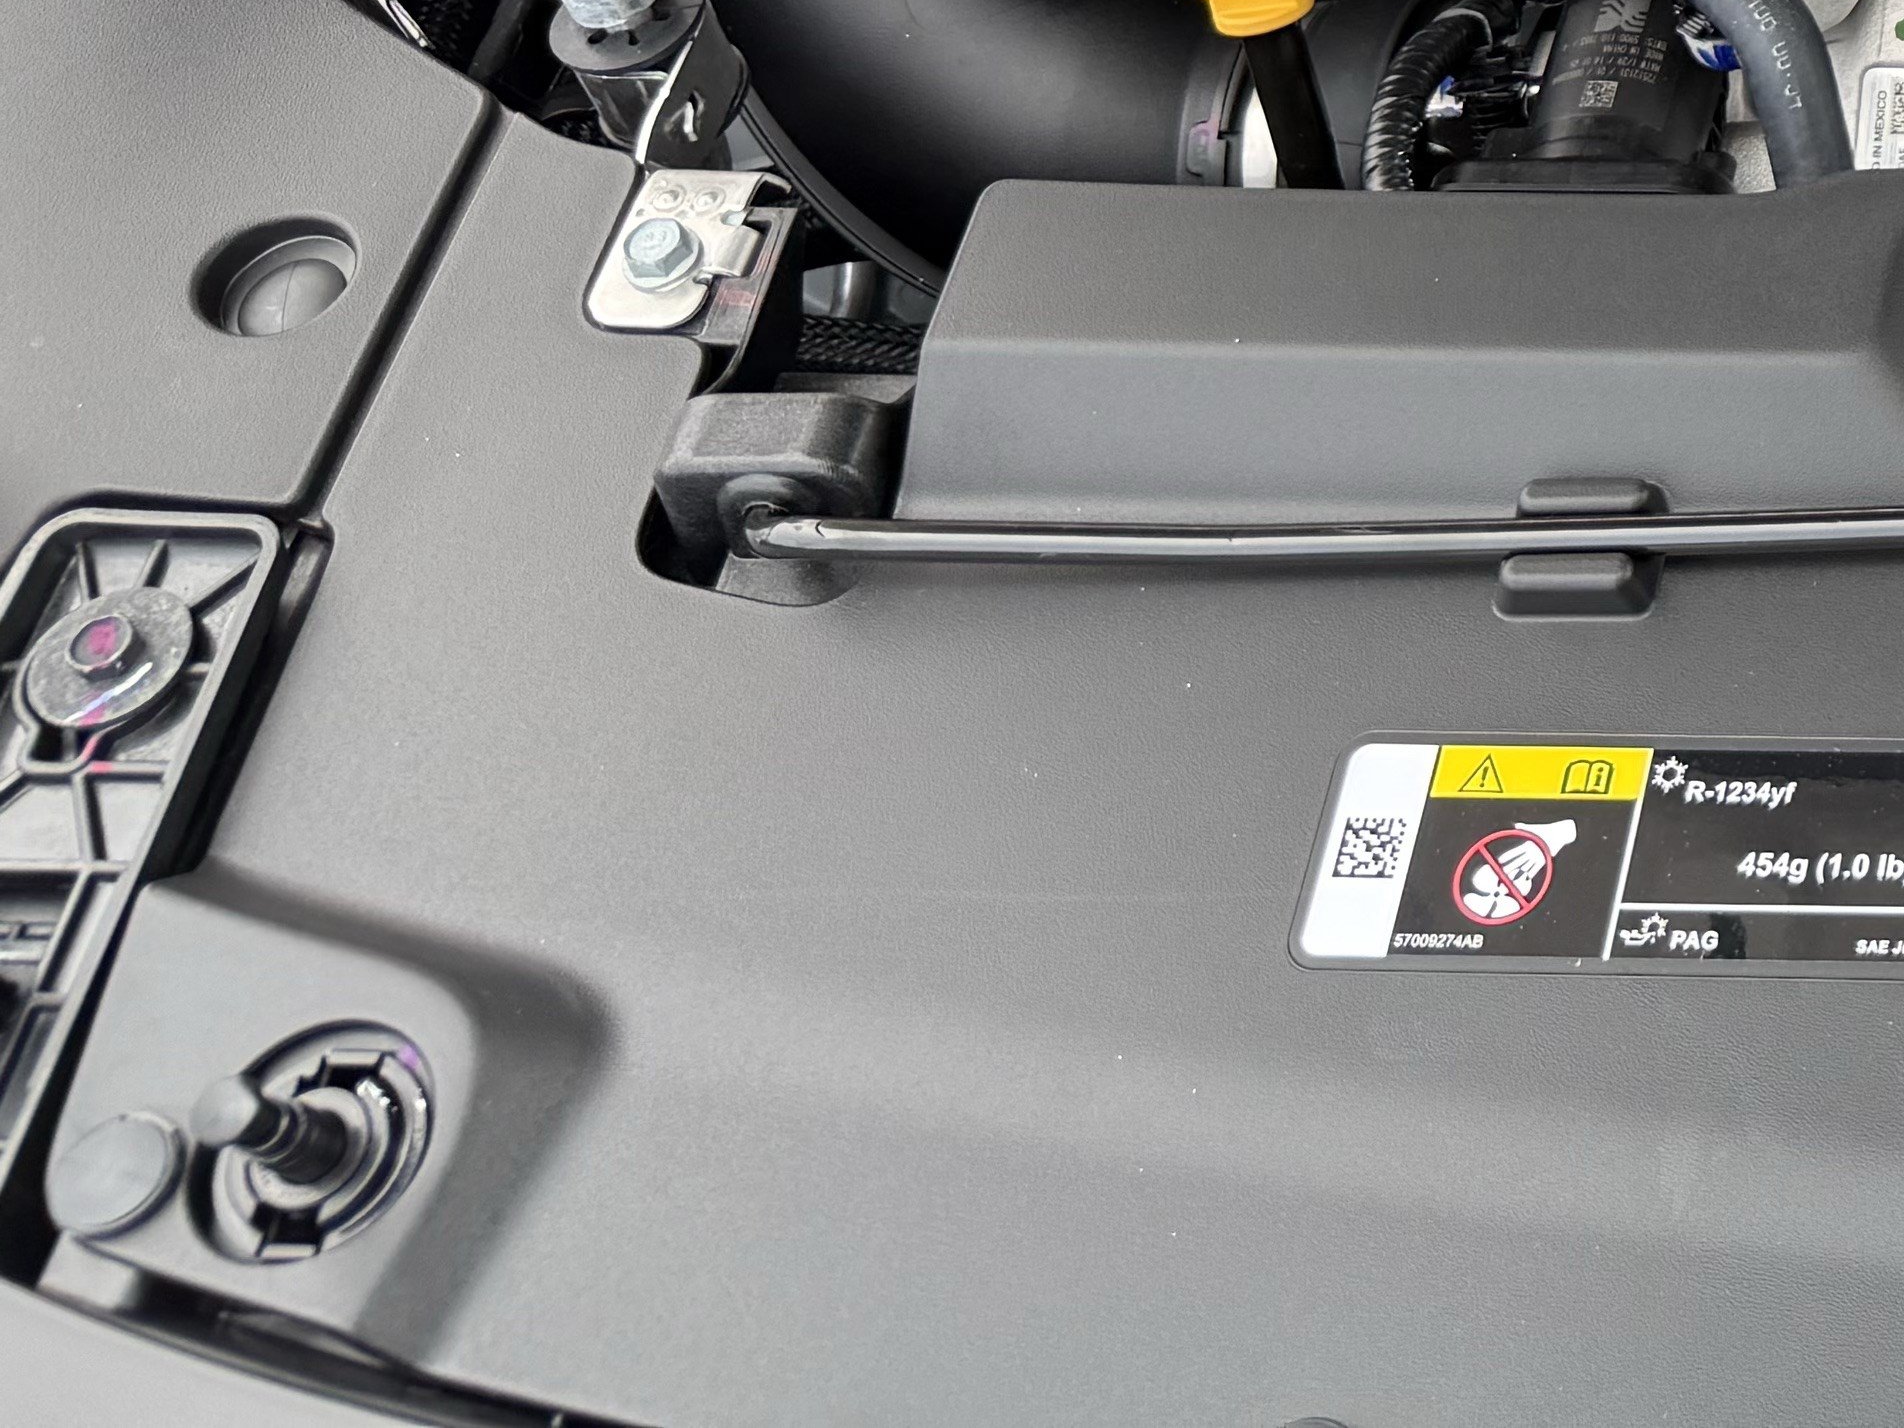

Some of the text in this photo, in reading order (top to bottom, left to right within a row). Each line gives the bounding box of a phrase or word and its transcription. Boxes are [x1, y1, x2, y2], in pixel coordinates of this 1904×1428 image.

[1874, 90, 1887, 143] MEXICO
[1873, 145, 1883, 158] IN
[1683, 779, 1798, 811] R-1234yf
[1737, 852, 1809, 885] 454g
[1815, 852, 1870, 886] (1.0
[1394, 932, 1484, 950] 57009274AB
[1669, 930, 1719, 951] PAG
[1856, 938, 1889, 955] SAE
